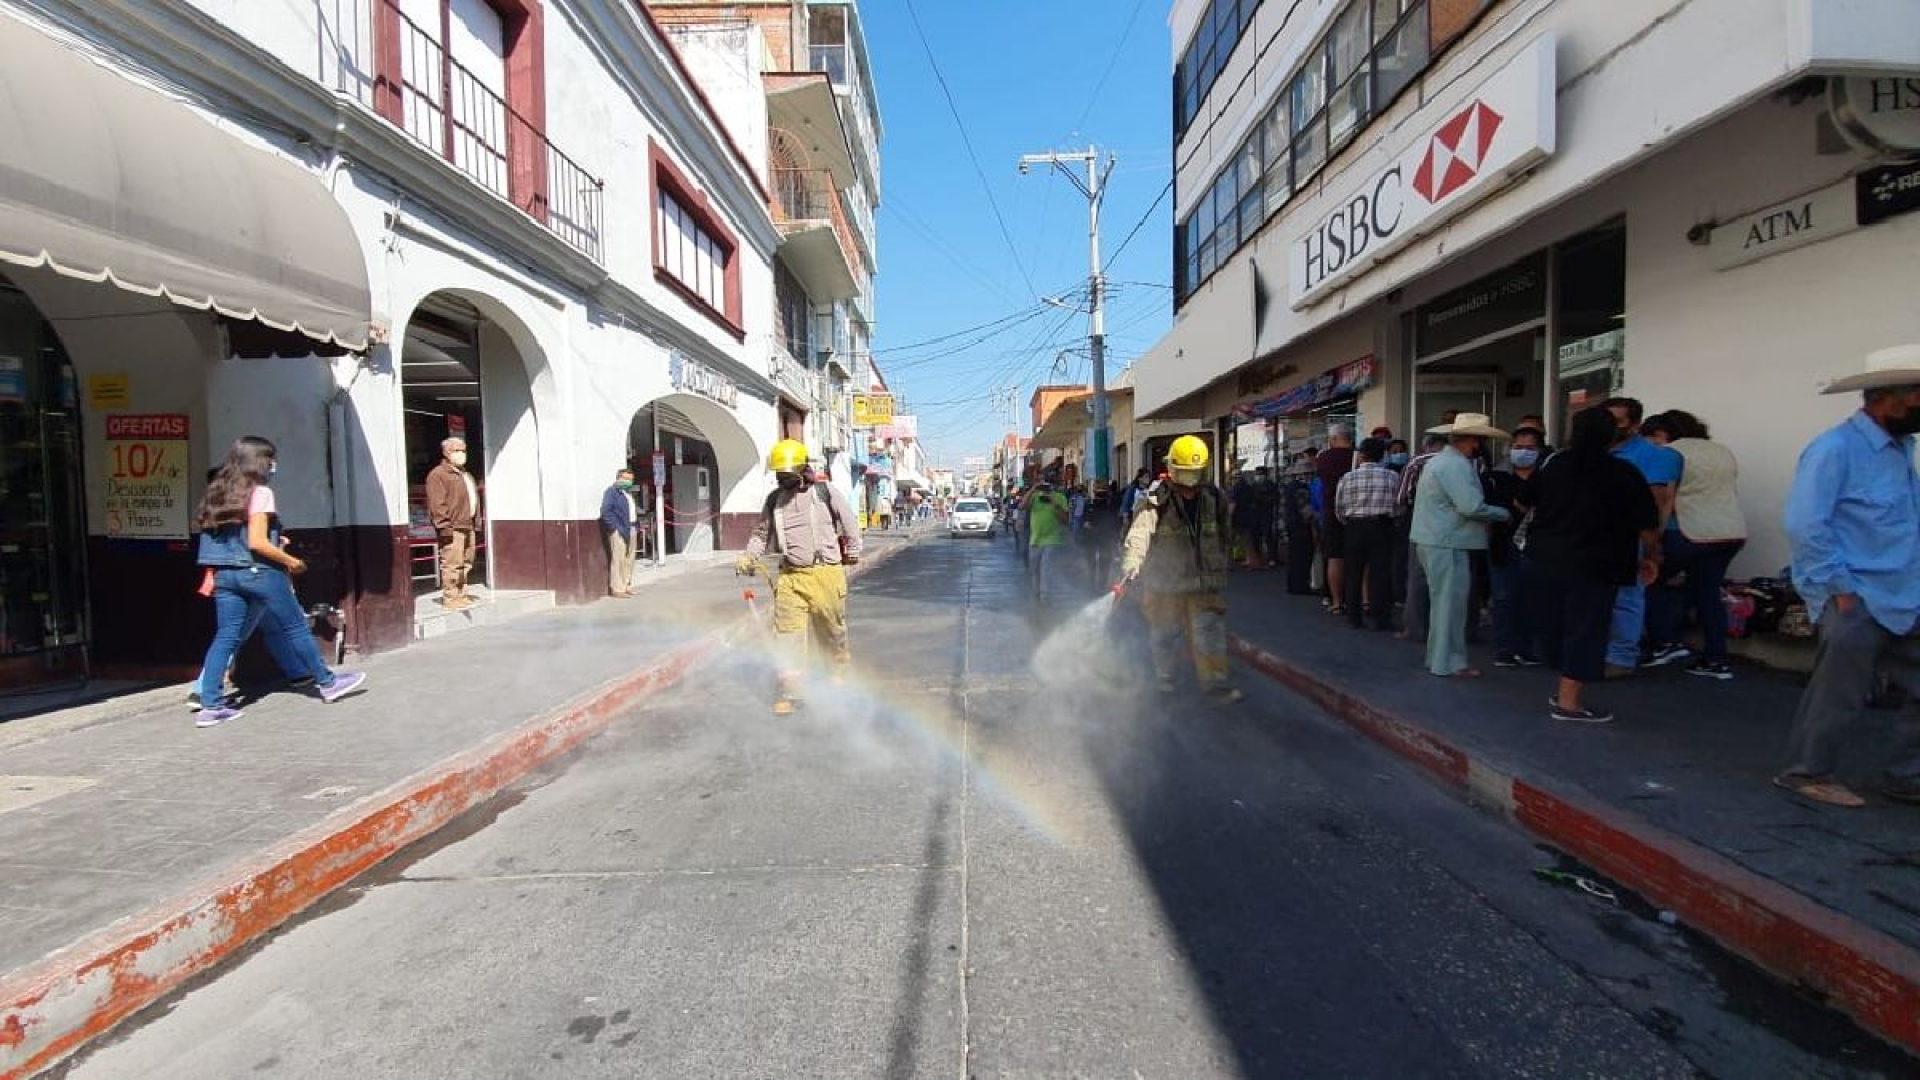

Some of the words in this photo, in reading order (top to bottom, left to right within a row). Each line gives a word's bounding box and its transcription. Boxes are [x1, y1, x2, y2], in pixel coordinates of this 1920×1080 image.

[1304, 161, 1403, 290] HSBC
[1744, 203, 1813, 249] ATM
[109, 417, 185, 435] OFERTAS
[113, 443, 165, 477] 10%
